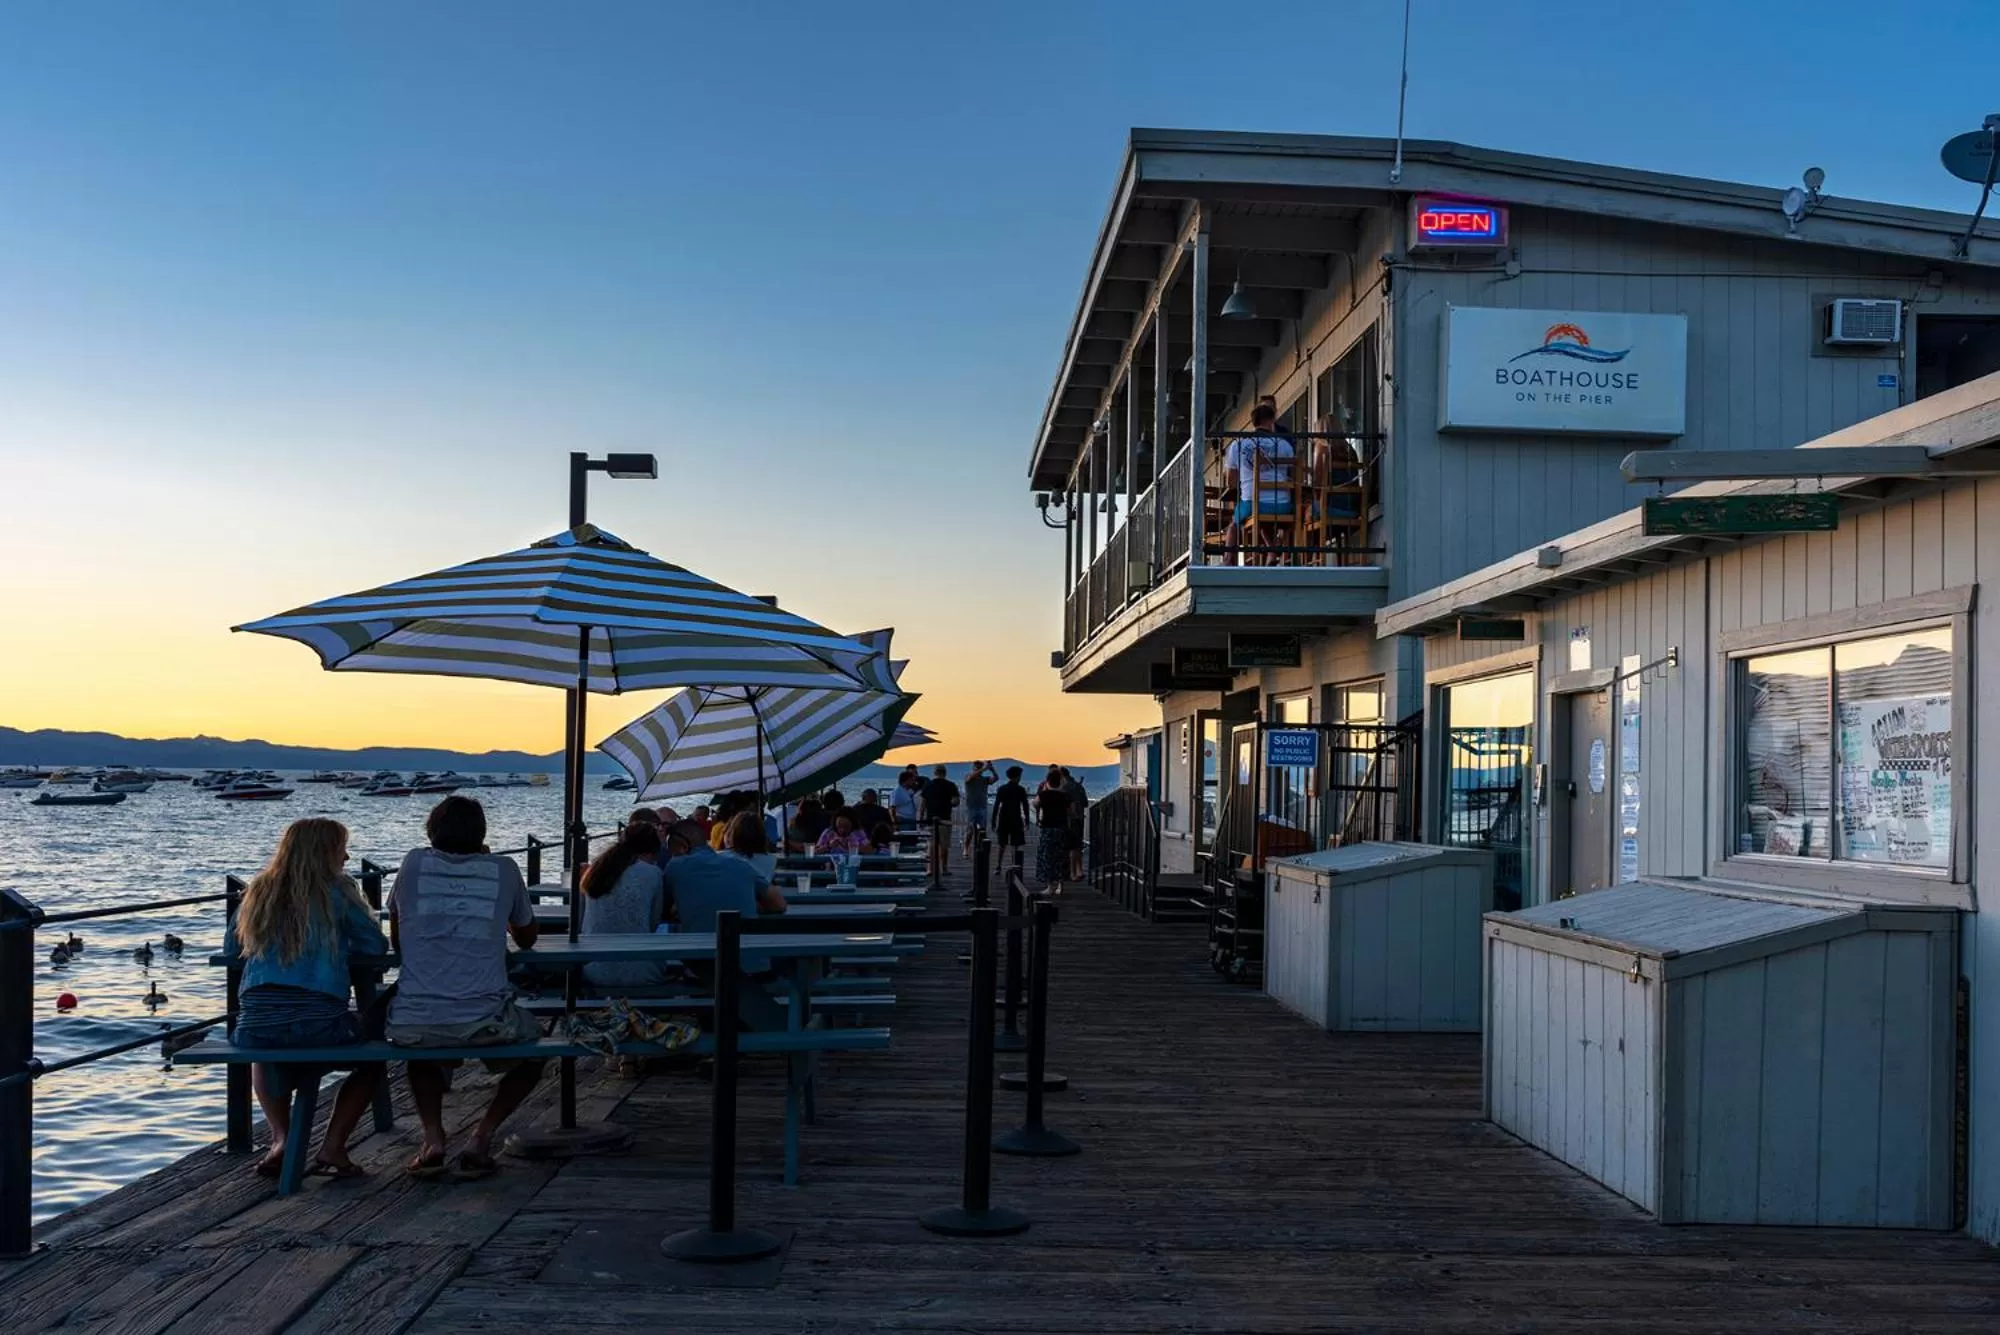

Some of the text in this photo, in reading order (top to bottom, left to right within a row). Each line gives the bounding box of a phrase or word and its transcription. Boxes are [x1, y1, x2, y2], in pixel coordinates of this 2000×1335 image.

[1420, 212, 1489, 232] OPEN
[1496, 368, 1640, 390] BOATHOUSE
[1515, 392, 1613, 405] ON THE PIER
[1871, 706, 1906, 748] ACTION
[1273, 735, 1312, 746] SORRY
[1285, 747, 1311, 755] PUBLIC
[1271, 754, 1313, 762] RESTROOMS
